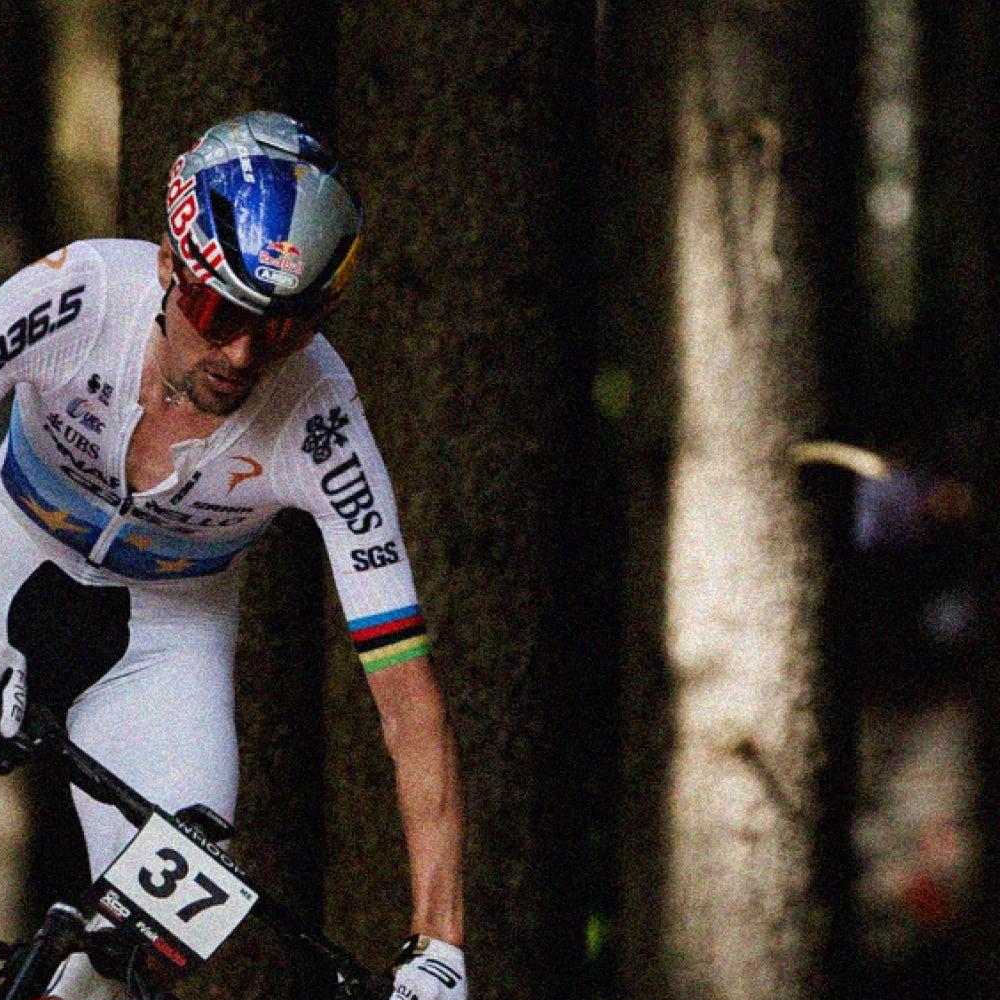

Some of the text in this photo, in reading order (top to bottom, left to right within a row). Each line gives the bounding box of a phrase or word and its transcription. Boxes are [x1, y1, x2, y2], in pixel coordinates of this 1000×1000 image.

[169, 193, 225, 284] Bull
[64, 428, 100, 460] UBS
[321, 451, 383, 536] UBS
[351, 541, 400, 572] SGS
[138, 847, 230, 924] 37
